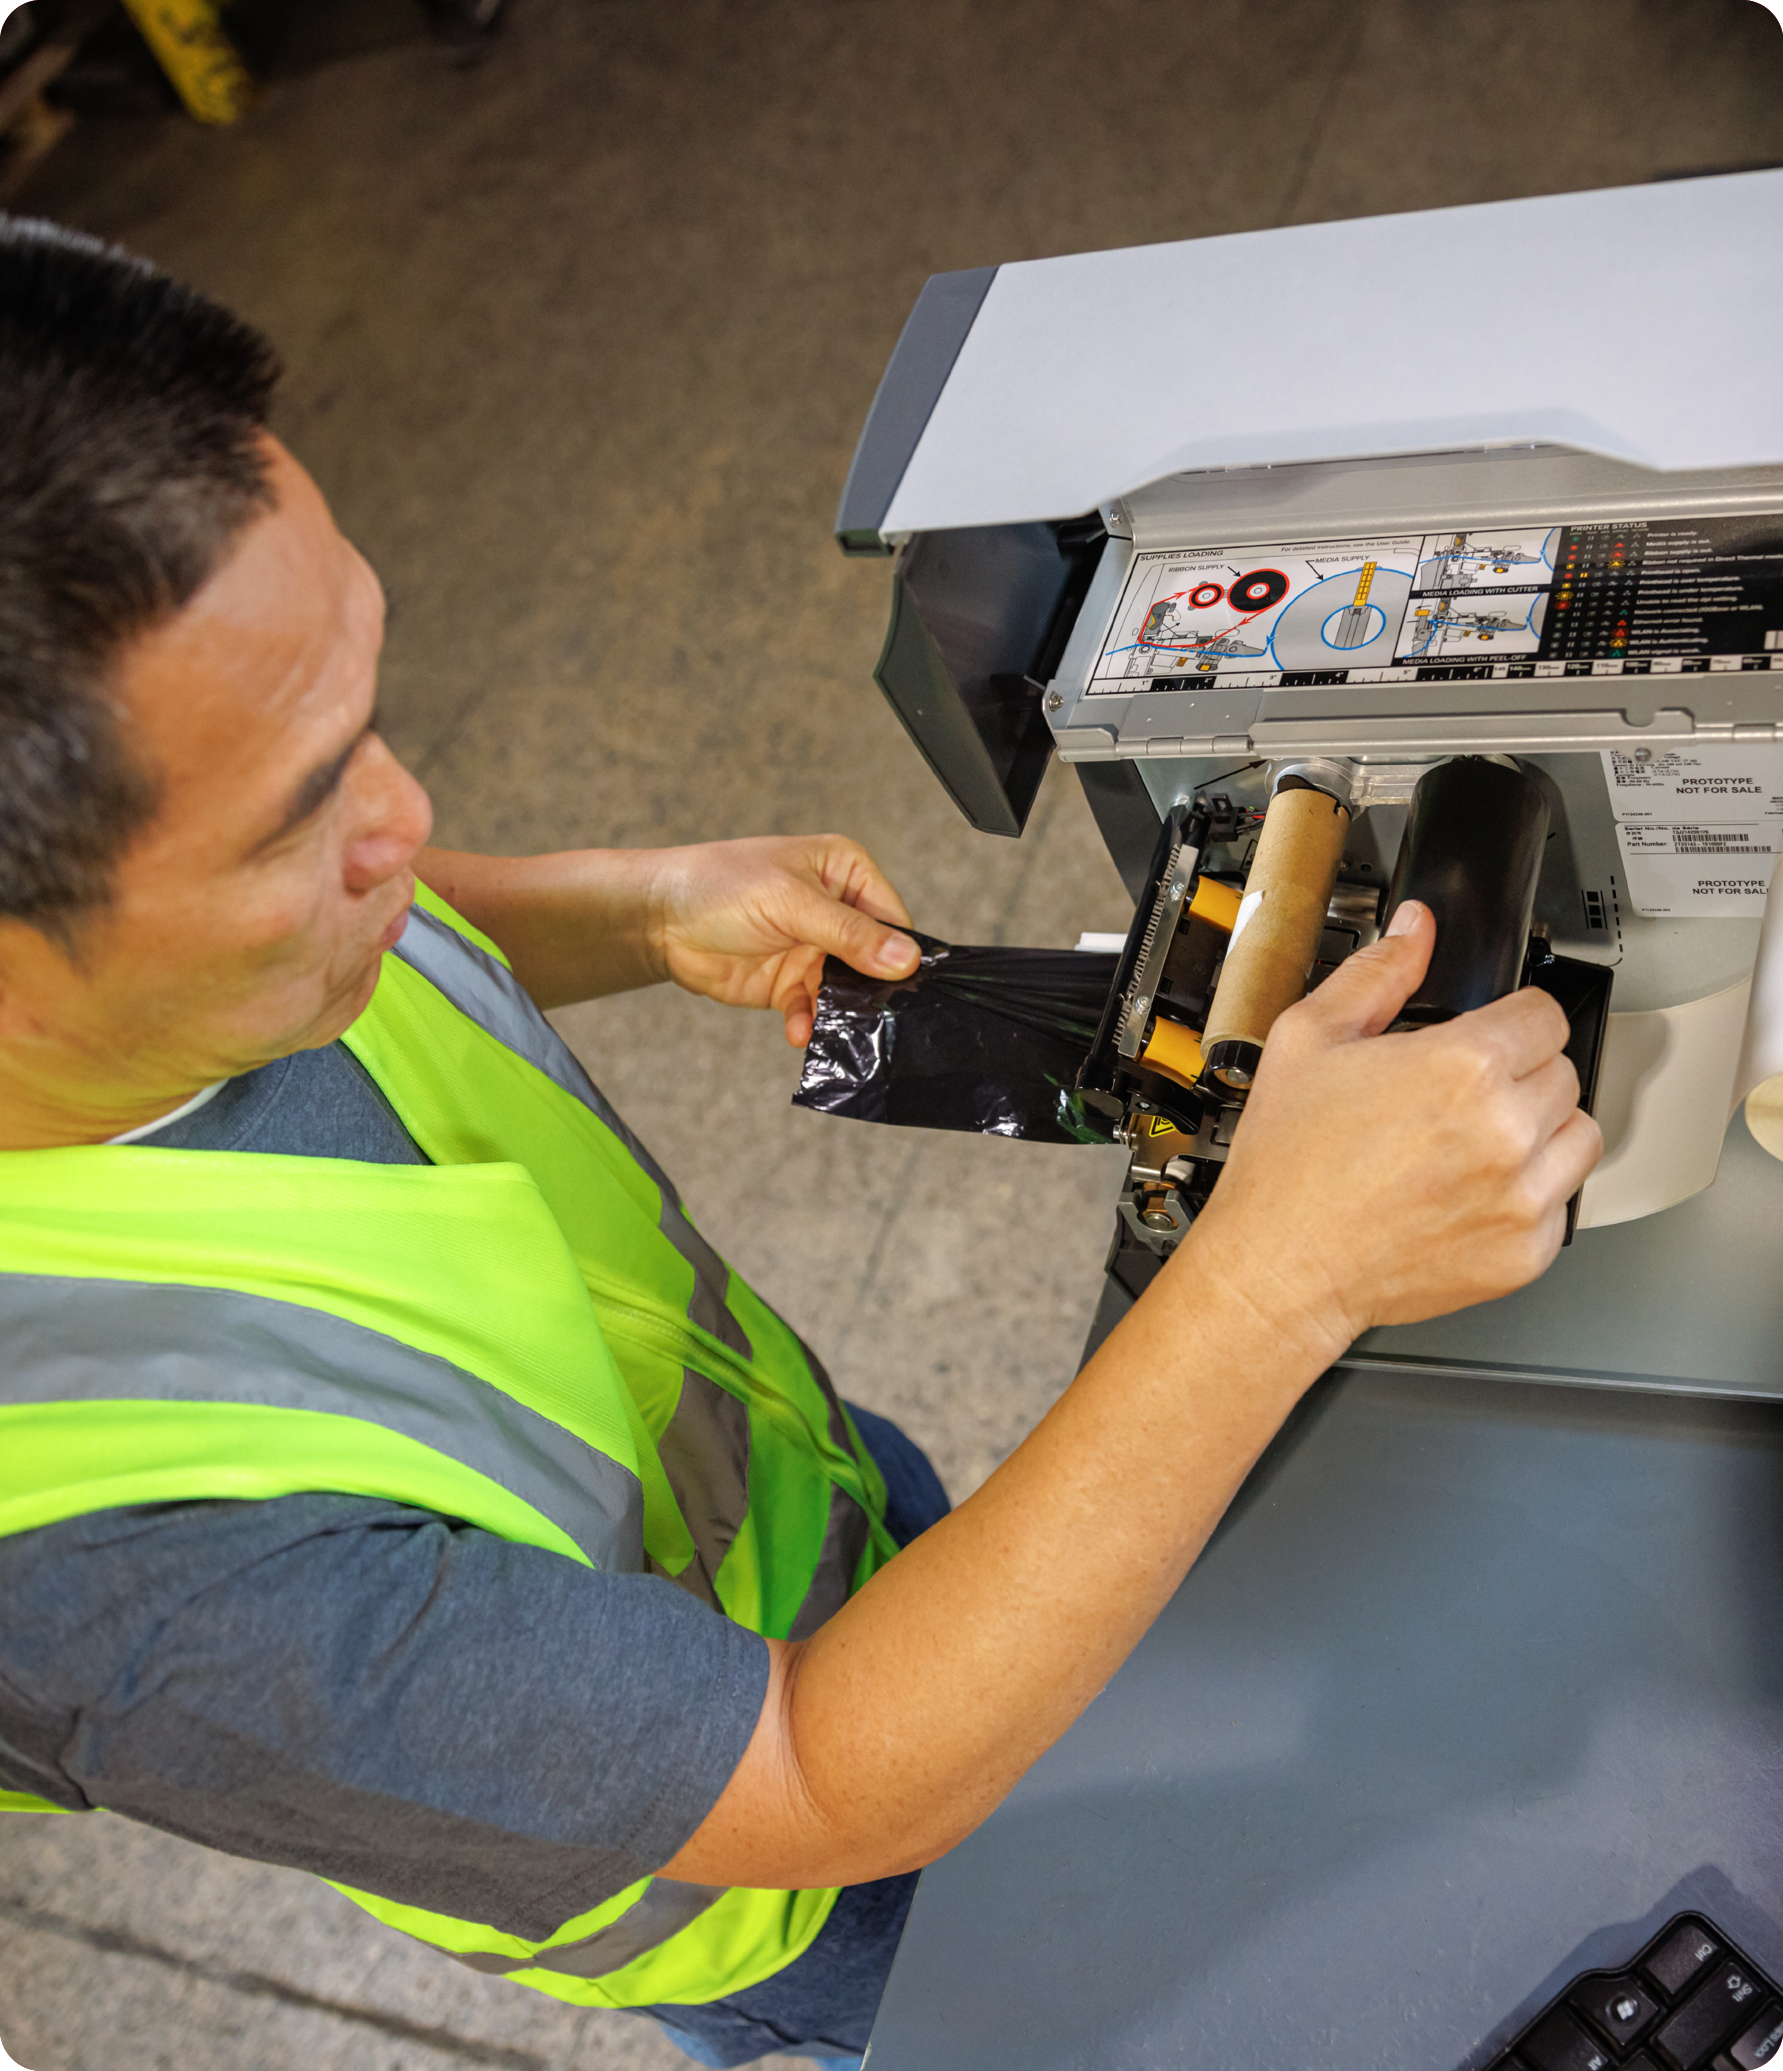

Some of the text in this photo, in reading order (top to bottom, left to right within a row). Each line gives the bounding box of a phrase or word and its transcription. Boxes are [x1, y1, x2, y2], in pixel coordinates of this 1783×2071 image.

[1571, 521, 1648, 532] PRINTER STATUS
[1140, 550, 1224, 561] SUPPLIES LOADING
[1489, 654, 1528, 662] PEEL-OFF
[1695, 1944, 1712, 1962] Ctrl
[1732, 1982, 1753, 2002] Shift
[1754, 2038, 1776, 2059] Lock
[1588, 2055, 1602, 2070] Alt
